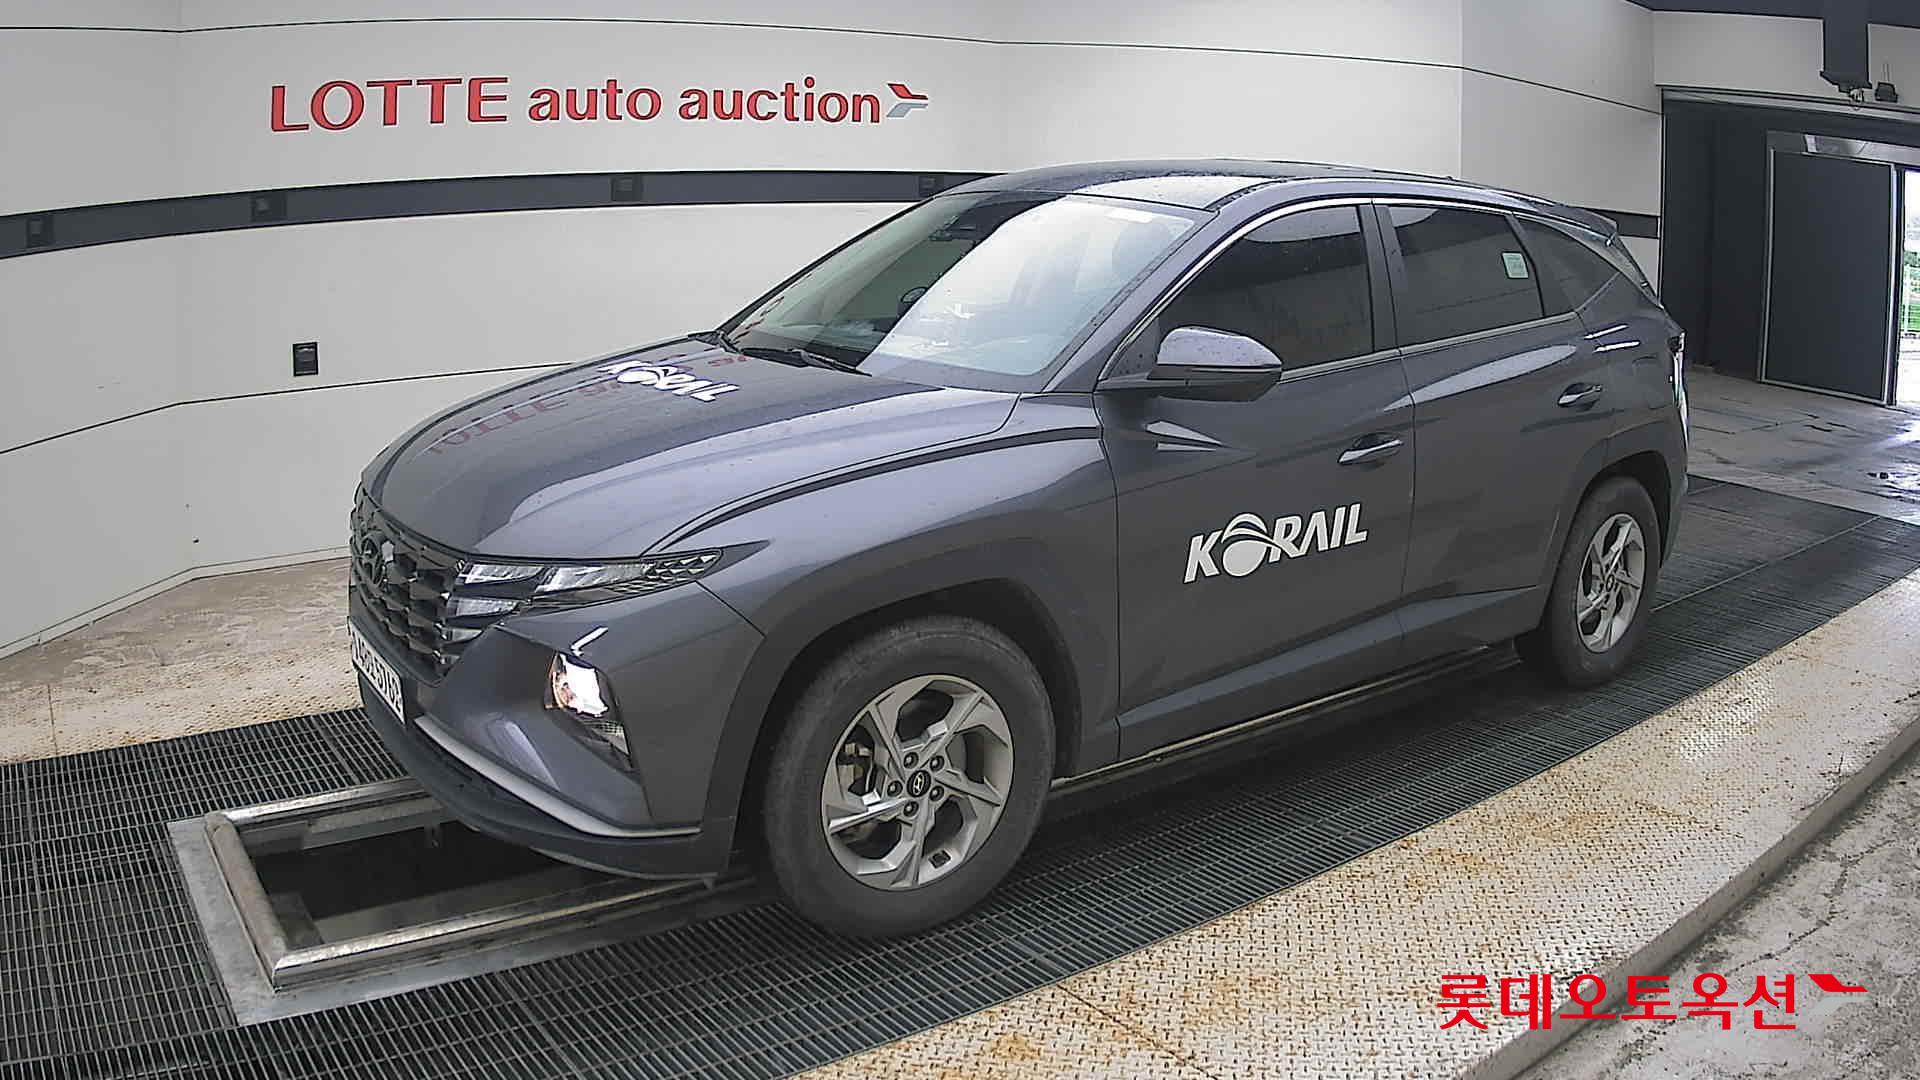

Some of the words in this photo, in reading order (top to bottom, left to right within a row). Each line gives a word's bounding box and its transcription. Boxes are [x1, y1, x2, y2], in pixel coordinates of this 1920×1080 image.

[271, 77, 508, 132] LOTTE
[528, 79, 662, 121] auto
[679, 77, 880, 123] auction
[1183, 503, 1368, 583] KORAIL
